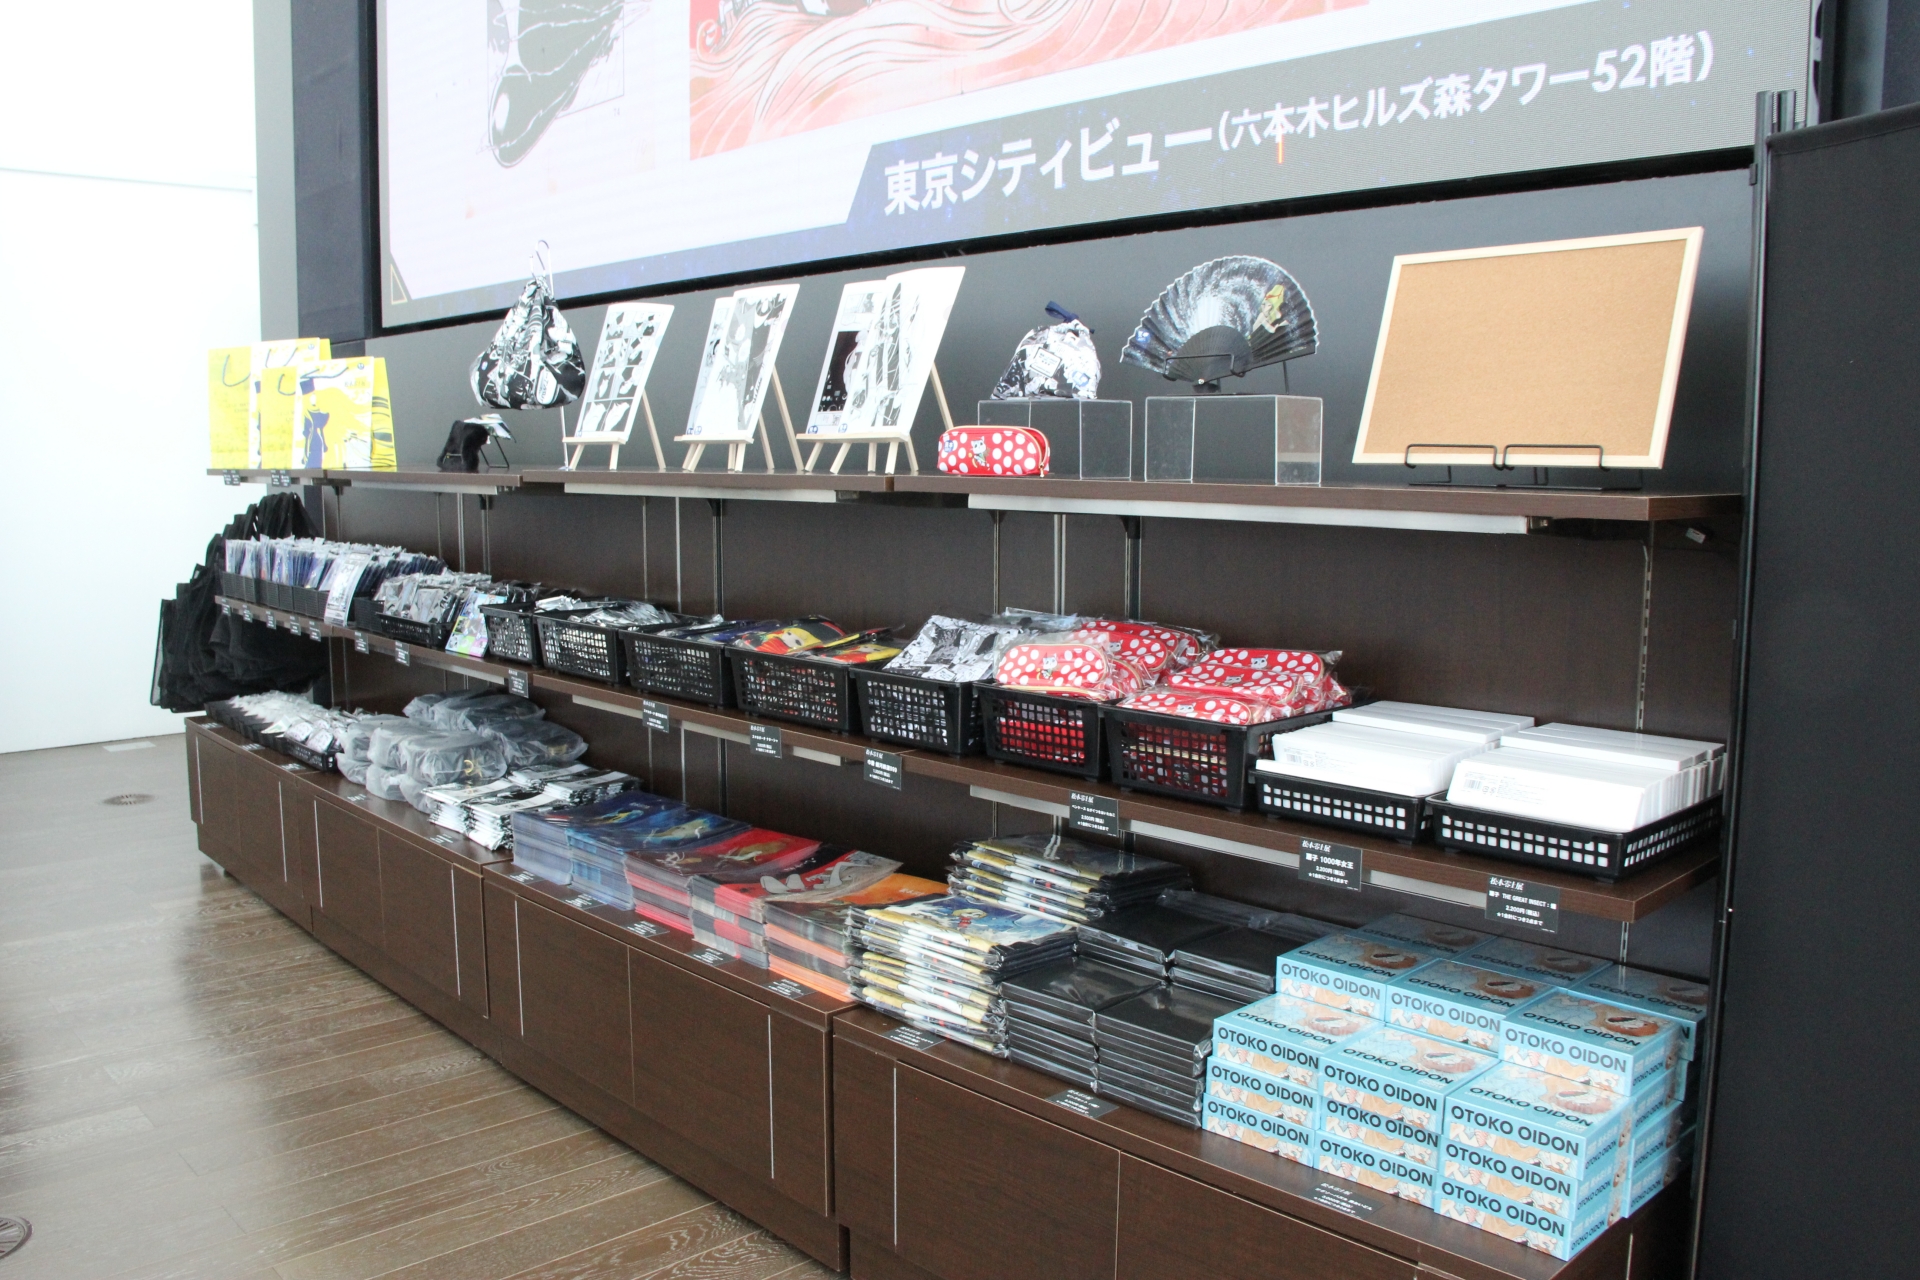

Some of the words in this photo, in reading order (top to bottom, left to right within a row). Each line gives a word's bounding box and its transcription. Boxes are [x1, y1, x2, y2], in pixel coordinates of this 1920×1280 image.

[883, 29, 1714, 217] 東京シティビュー(六本木ヒルズ森タワー52階)
[1302, 840, 1332, 852] 松本零士展
[1320, 856, 1354, 870] 1000年女王
[1490, 876, 1525, 890] 松本零士展
[1512, 895, 1528, 903] GREAT
[1282, 964, 1330, 986] OTOKO
[1333, 978, 1380, 1000] OIDON
[1299, 950, 1347, 964] OTOKO
[1349, 963, 1396, 977] OIDON
[1471, 954, 1522, 968] OTOKO
[1525, 966, 1576, 982] OIDON
[1391, 992, 1444, 1016] OTOKO
[1448, 1008, 1500, 1032] OIDON
[1408, 978, 1461, 993] OTOKO
[1464, 992, 1515, 1008] OIDON
[1589, 983, 1644, 998] OTOKO
[1648, 997, 1703, 1014] OIDON
[1237, 1012, 1286, 1028] OTOKO
[1288, 1028, 1336, 1044] OIDON
[1523, 1012, 1581, 1030] OTOKO
[1584, 1028, 1641, 1046] OIDON
[1218, 1027, 1267, 1052] OTOKO
[1271, 1044, 1319, 1069] OIDON
[1344, 1048, 1398, 1066] OTOKO
[1400, 1066, 1454, 1084] OIDON
[1506, 1028, 1564, 1054] OTOKO
[1569, 1046, 1626, 1072] OIDON
[1212, 1066, 1261, 1090] OTOKO
[1265, 1083, 1313, 1108] OIDON
[1324, 1065, 1380, 1092] OTOKO
[1384, 1084, 1437, 1111] OIDON
[1470, 1087, 1530, 1108] OTOKO
[1534, 1106, 1594, 1126] OIDON
[1208, 1101, 1258, 1126] OTOKO
[1261, 1120, 1308, 1146] OIDON
[1326, 1100, 1381, 1128] OTOKO
[1385, 1120, 1438, 1148] OIDON
[1451, 1106, 1514, 1134] OTOKO
[1518, 1126, 1579, 1156] OIDON
[1320, 1140, 1375, 1166] OTOKO
[1379, 1159, 1432, 1186] OIDON
[1446, 1144, 1506, 1174] OTOKO
[1511, 1166, 1571, 1196] OIDON
[1442, 1182, 1502, 1212] OTOKO
[1506, 1206, 1565, 1237] OIDON
